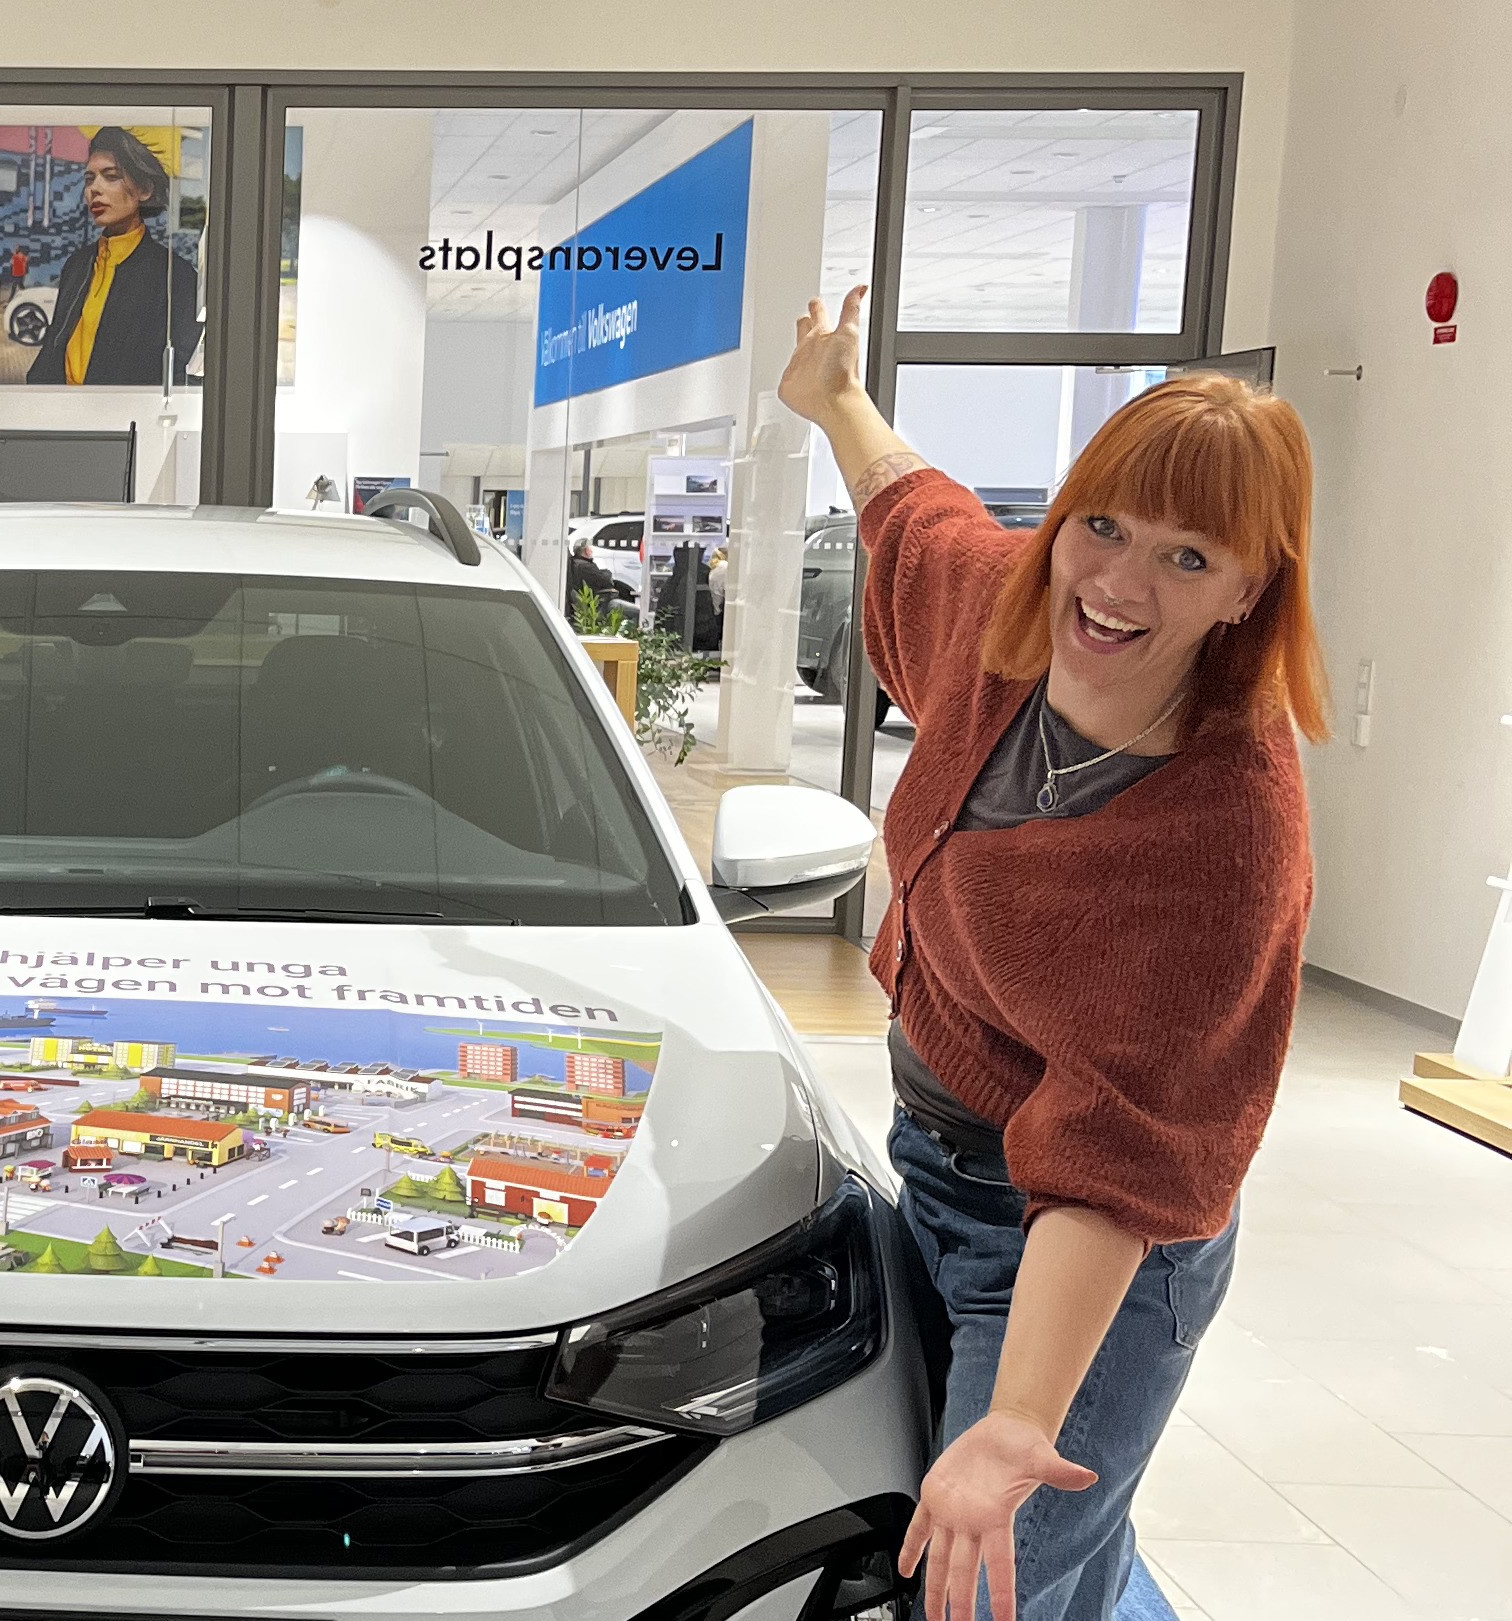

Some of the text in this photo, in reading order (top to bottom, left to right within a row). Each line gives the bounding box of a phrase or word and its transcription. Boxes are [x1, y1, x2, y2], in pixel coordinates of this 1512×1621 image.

[588, 299, 638, 349] Volkswagen
[0, 950, 192, 972] hjälper
[210, 960, 348, 979] unga
[7, 973, 177, 994] vägen
[200, 981, 312, 1000] mot
[331, 984, 619, 1023] framtiden
[367, 1079, 418, 1093] FABRIK
